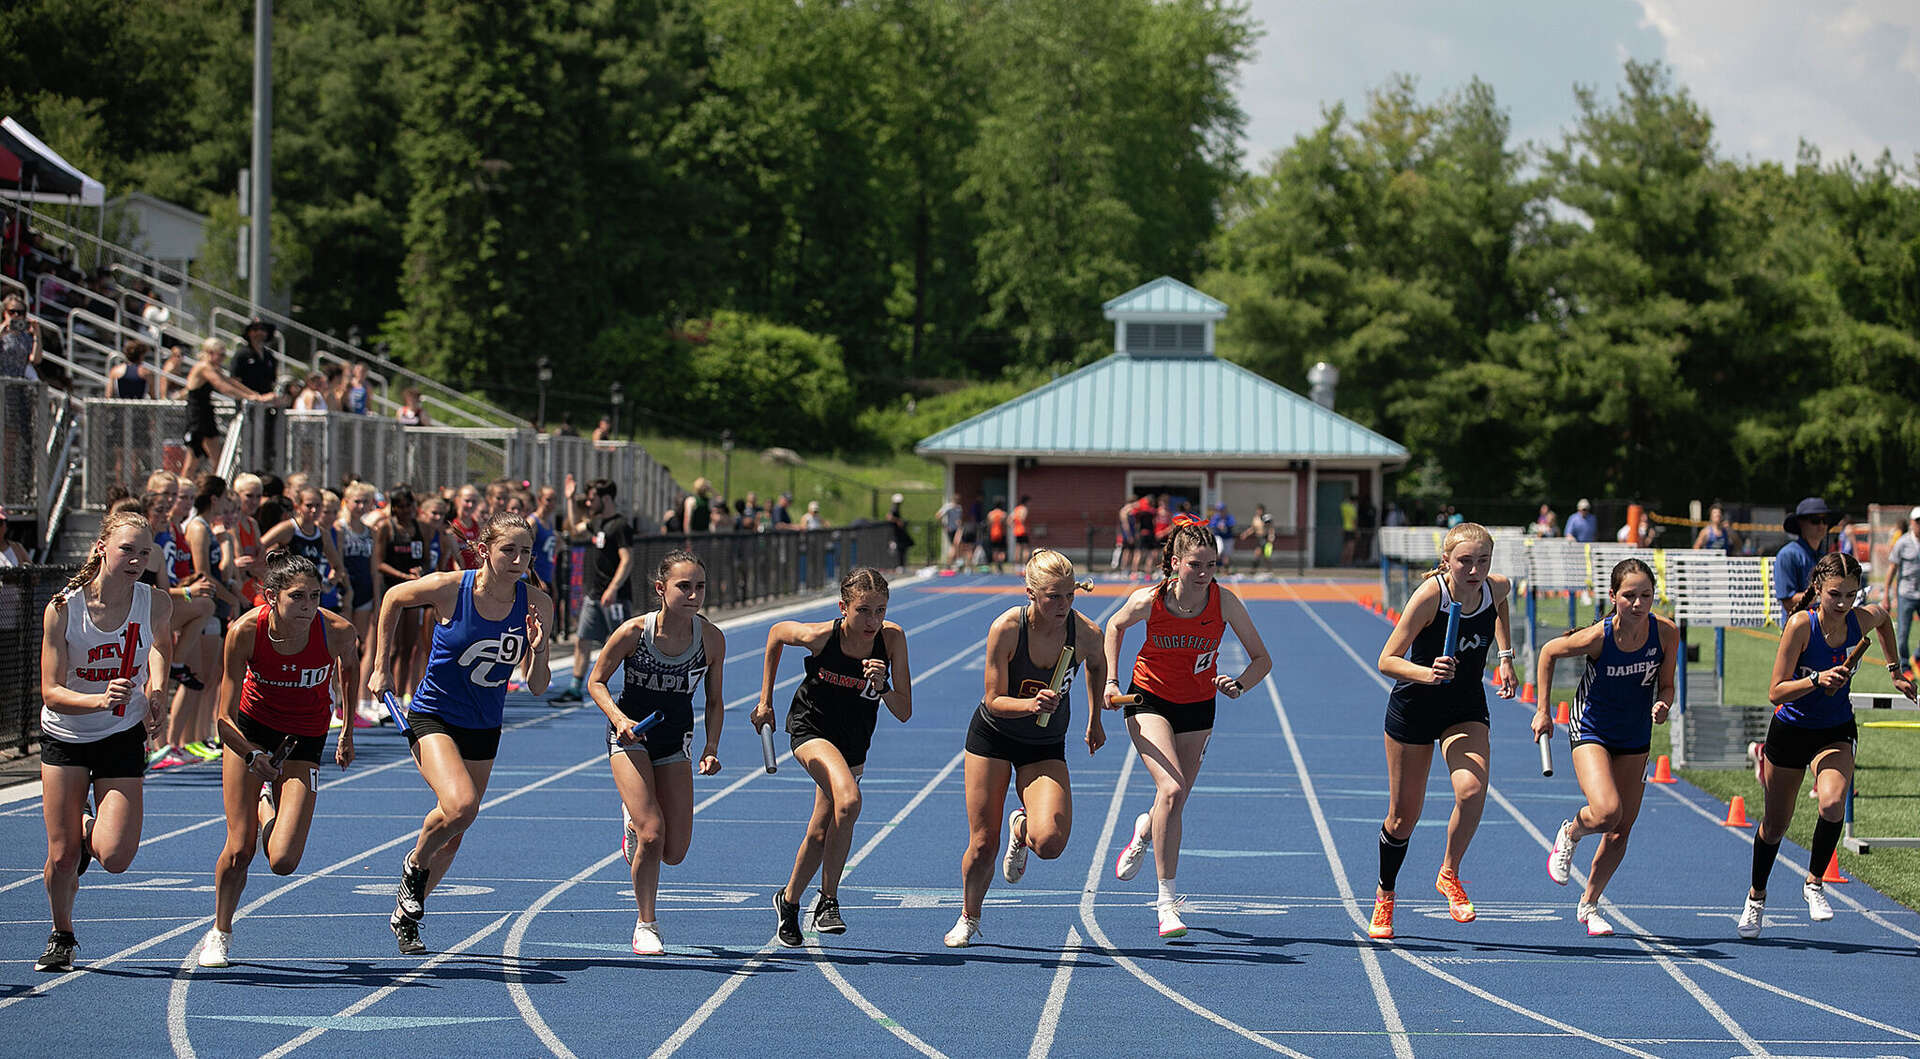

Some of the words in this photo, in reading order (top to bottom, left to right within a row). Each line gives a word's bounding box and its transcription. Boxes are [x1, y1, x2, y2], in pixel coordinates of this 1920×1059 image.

[500, 636, 519, 662] 9
[1460, 634, 1481, 652] W
[1197, 653, 1212, 669] 4
[1607, 661, 1655, 677] DARIEN
[303, 667, 328, 688] 10
[626, 667, 686, 692] STAPL
